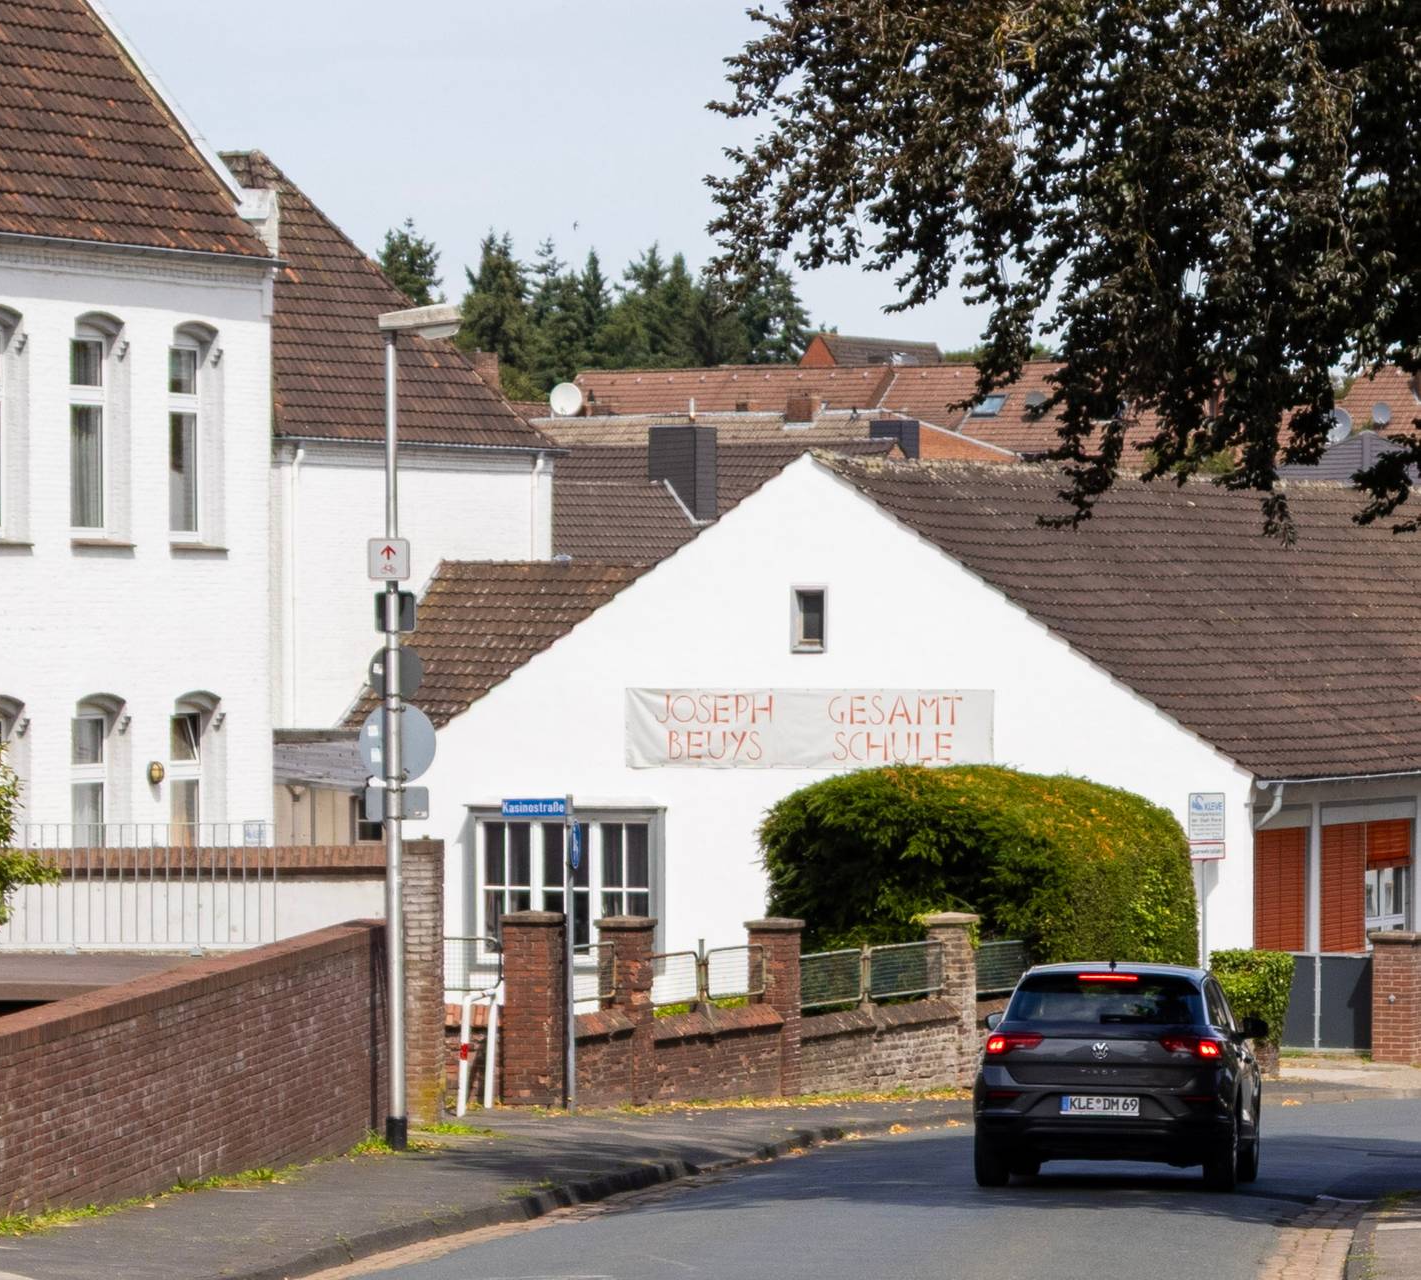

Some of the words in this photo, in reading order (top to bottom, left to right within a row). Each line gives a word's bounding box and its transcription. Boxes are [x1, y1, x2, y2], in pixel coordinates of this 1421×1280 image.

[655, 694, 773, 724] JOSEPH
[828, 695, 963, 725] GESAMT
[668, 730, 762, 760] BEUYS
[832, 731, 952, 761] SCHULE
[502, 801, 565, 814] Kasinostraße
[1121, 1098, 1138, 1111] 69
